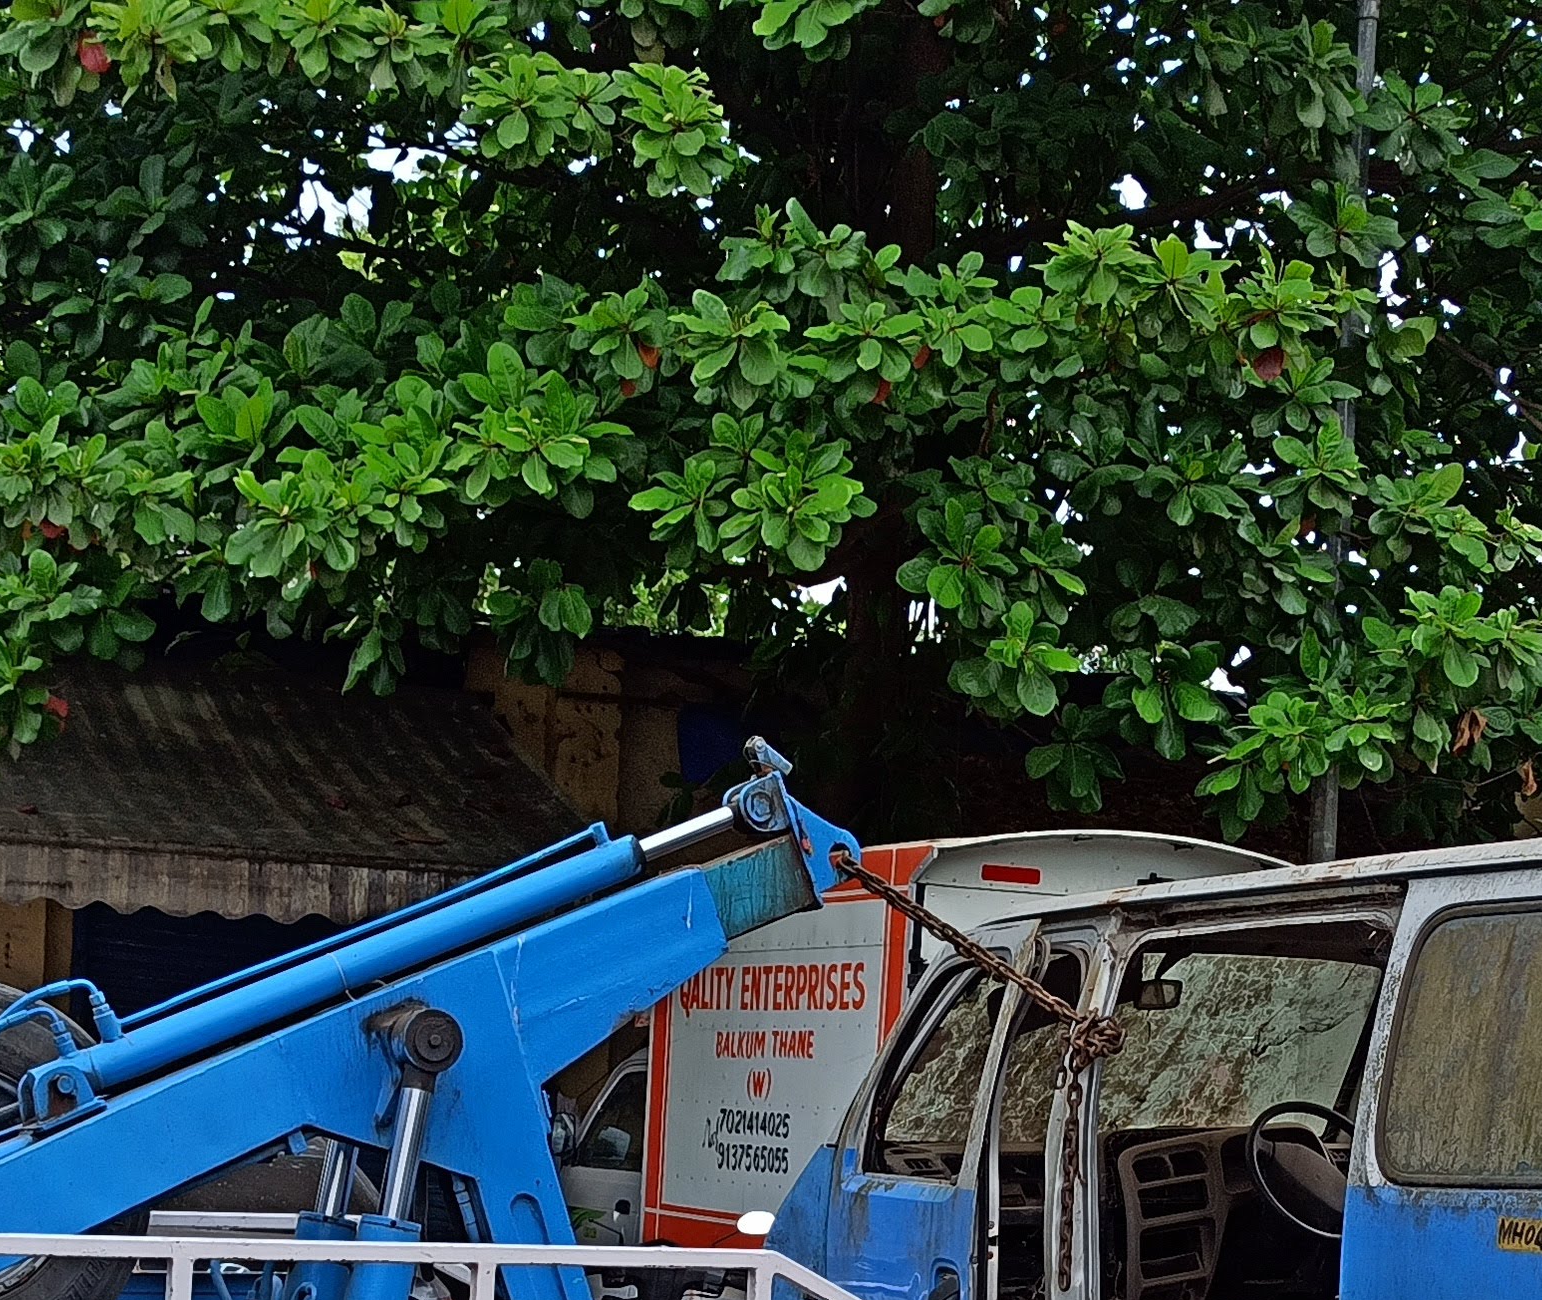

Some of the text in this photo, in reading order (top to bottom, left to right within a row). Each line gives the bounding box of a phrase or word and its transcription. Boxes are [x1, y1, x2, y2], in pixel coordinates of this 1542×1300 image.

[740, 963, 865, 1011] ENTERPRISES
[716, 1030, 814, 1059] BALKUM THANE
[746, 1068, 772, 1101] (W)
[720, 1108, 790, 1139] 7021414025
[717, 1142, 789, 1174] 9137565055
